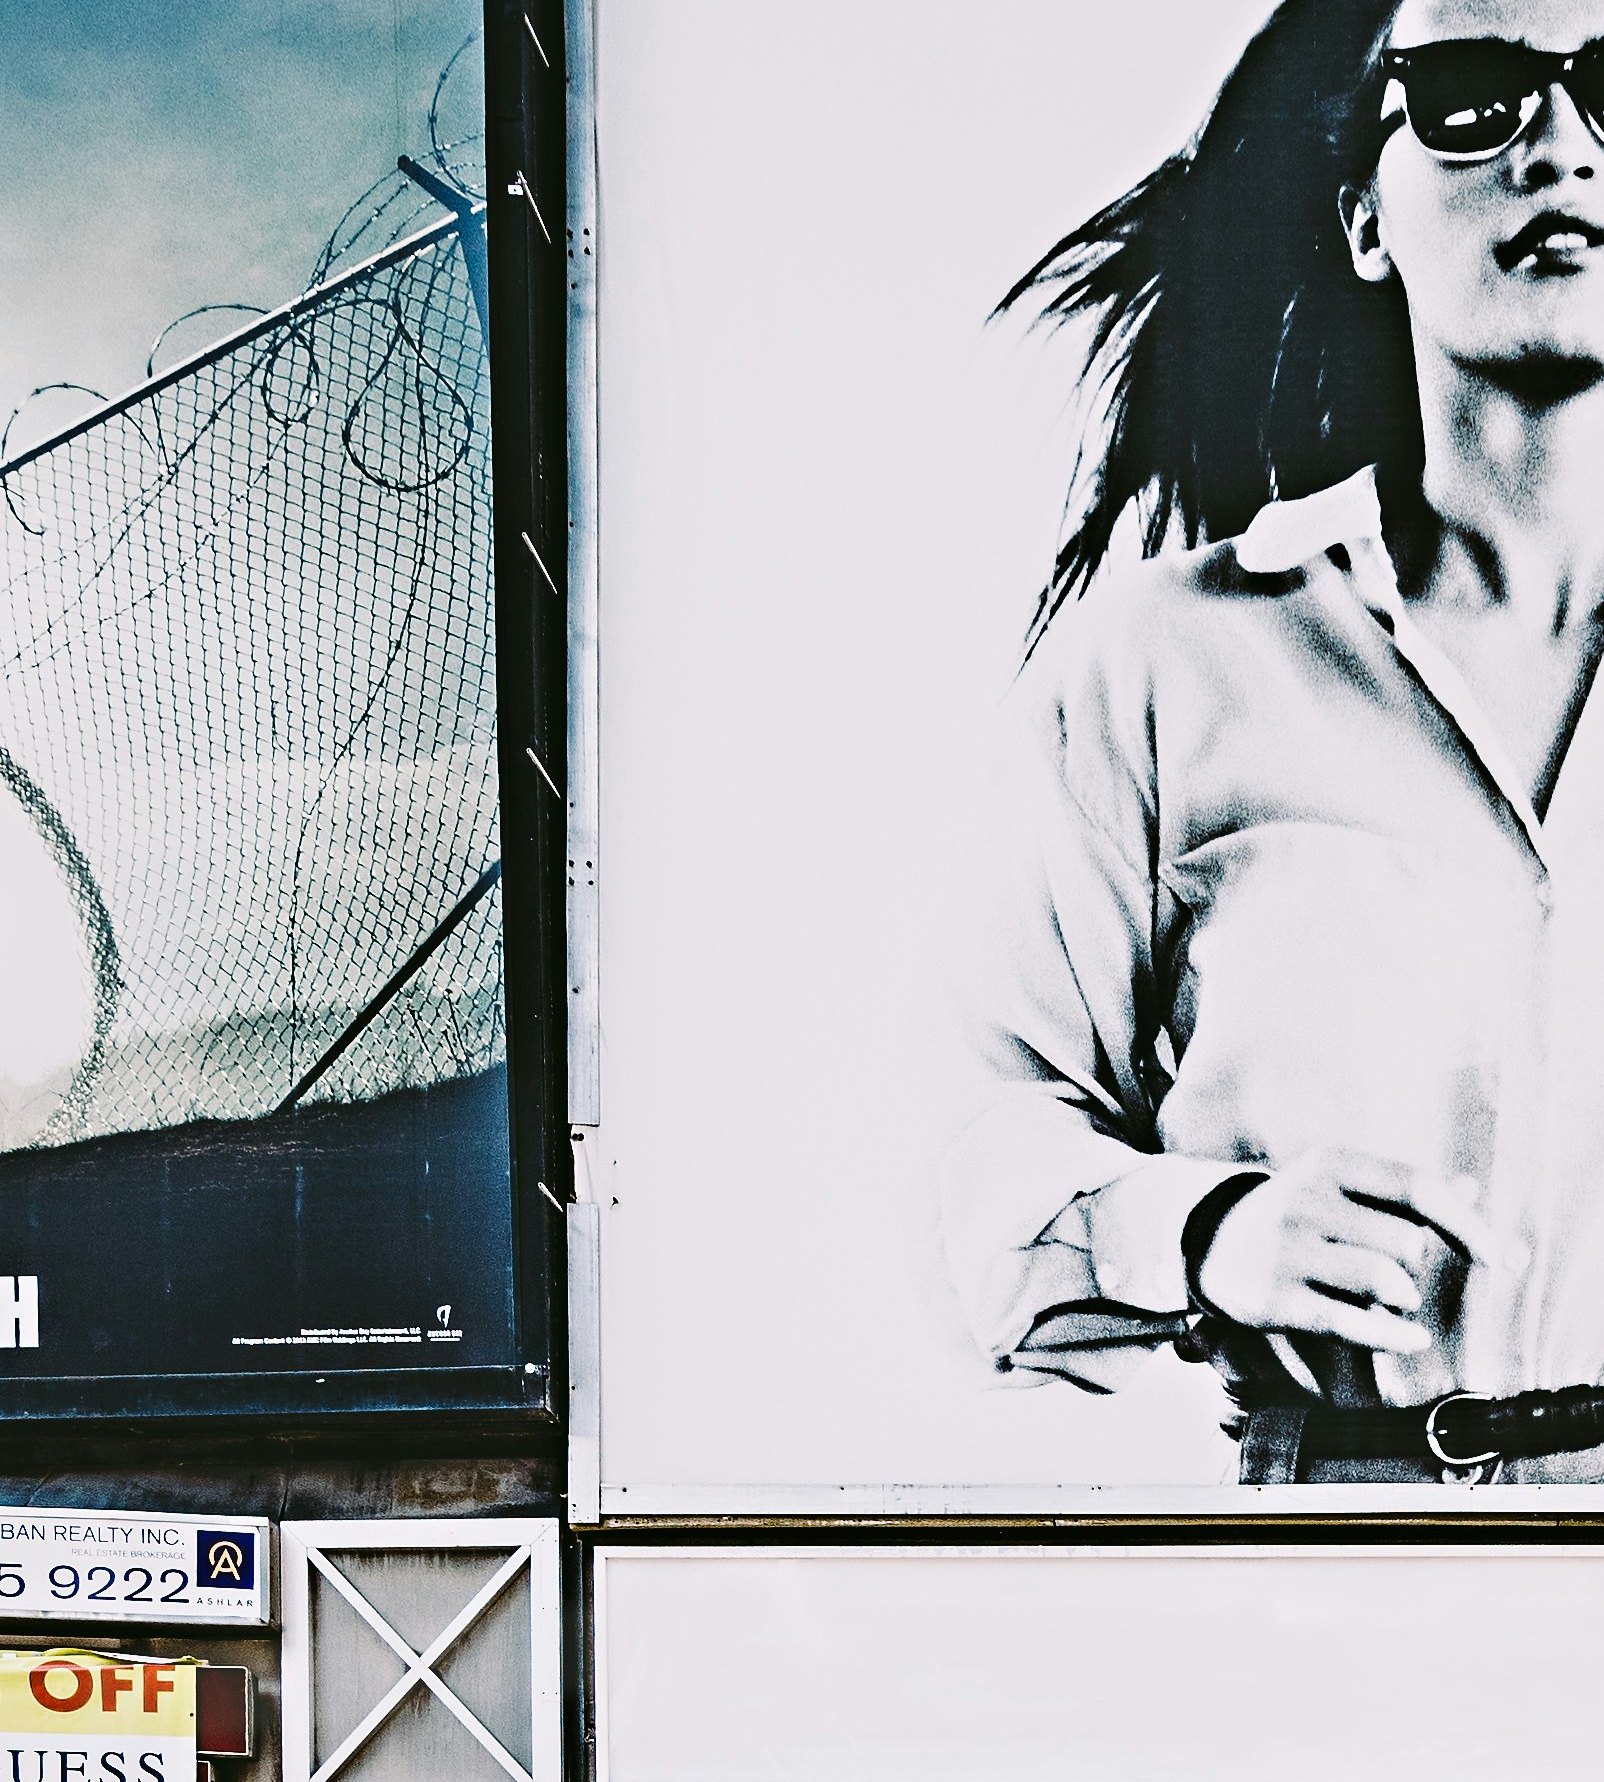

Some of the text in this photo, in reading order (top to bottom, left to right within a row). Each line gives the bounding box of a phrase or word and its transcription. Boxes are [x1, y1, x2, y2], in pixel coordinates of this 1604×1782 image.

[54, 1526, 133, 1544] REALTY
[141, 1528, 186, 1546] INC.
[72, 1548, 187, 1560] REAL ESTATE BROKERAGE
[49, 1564, 190, 1604] 9222
[196, 1597, 254, 1608] ASHLAR
[29, 1660, 176, 1713] OFF
